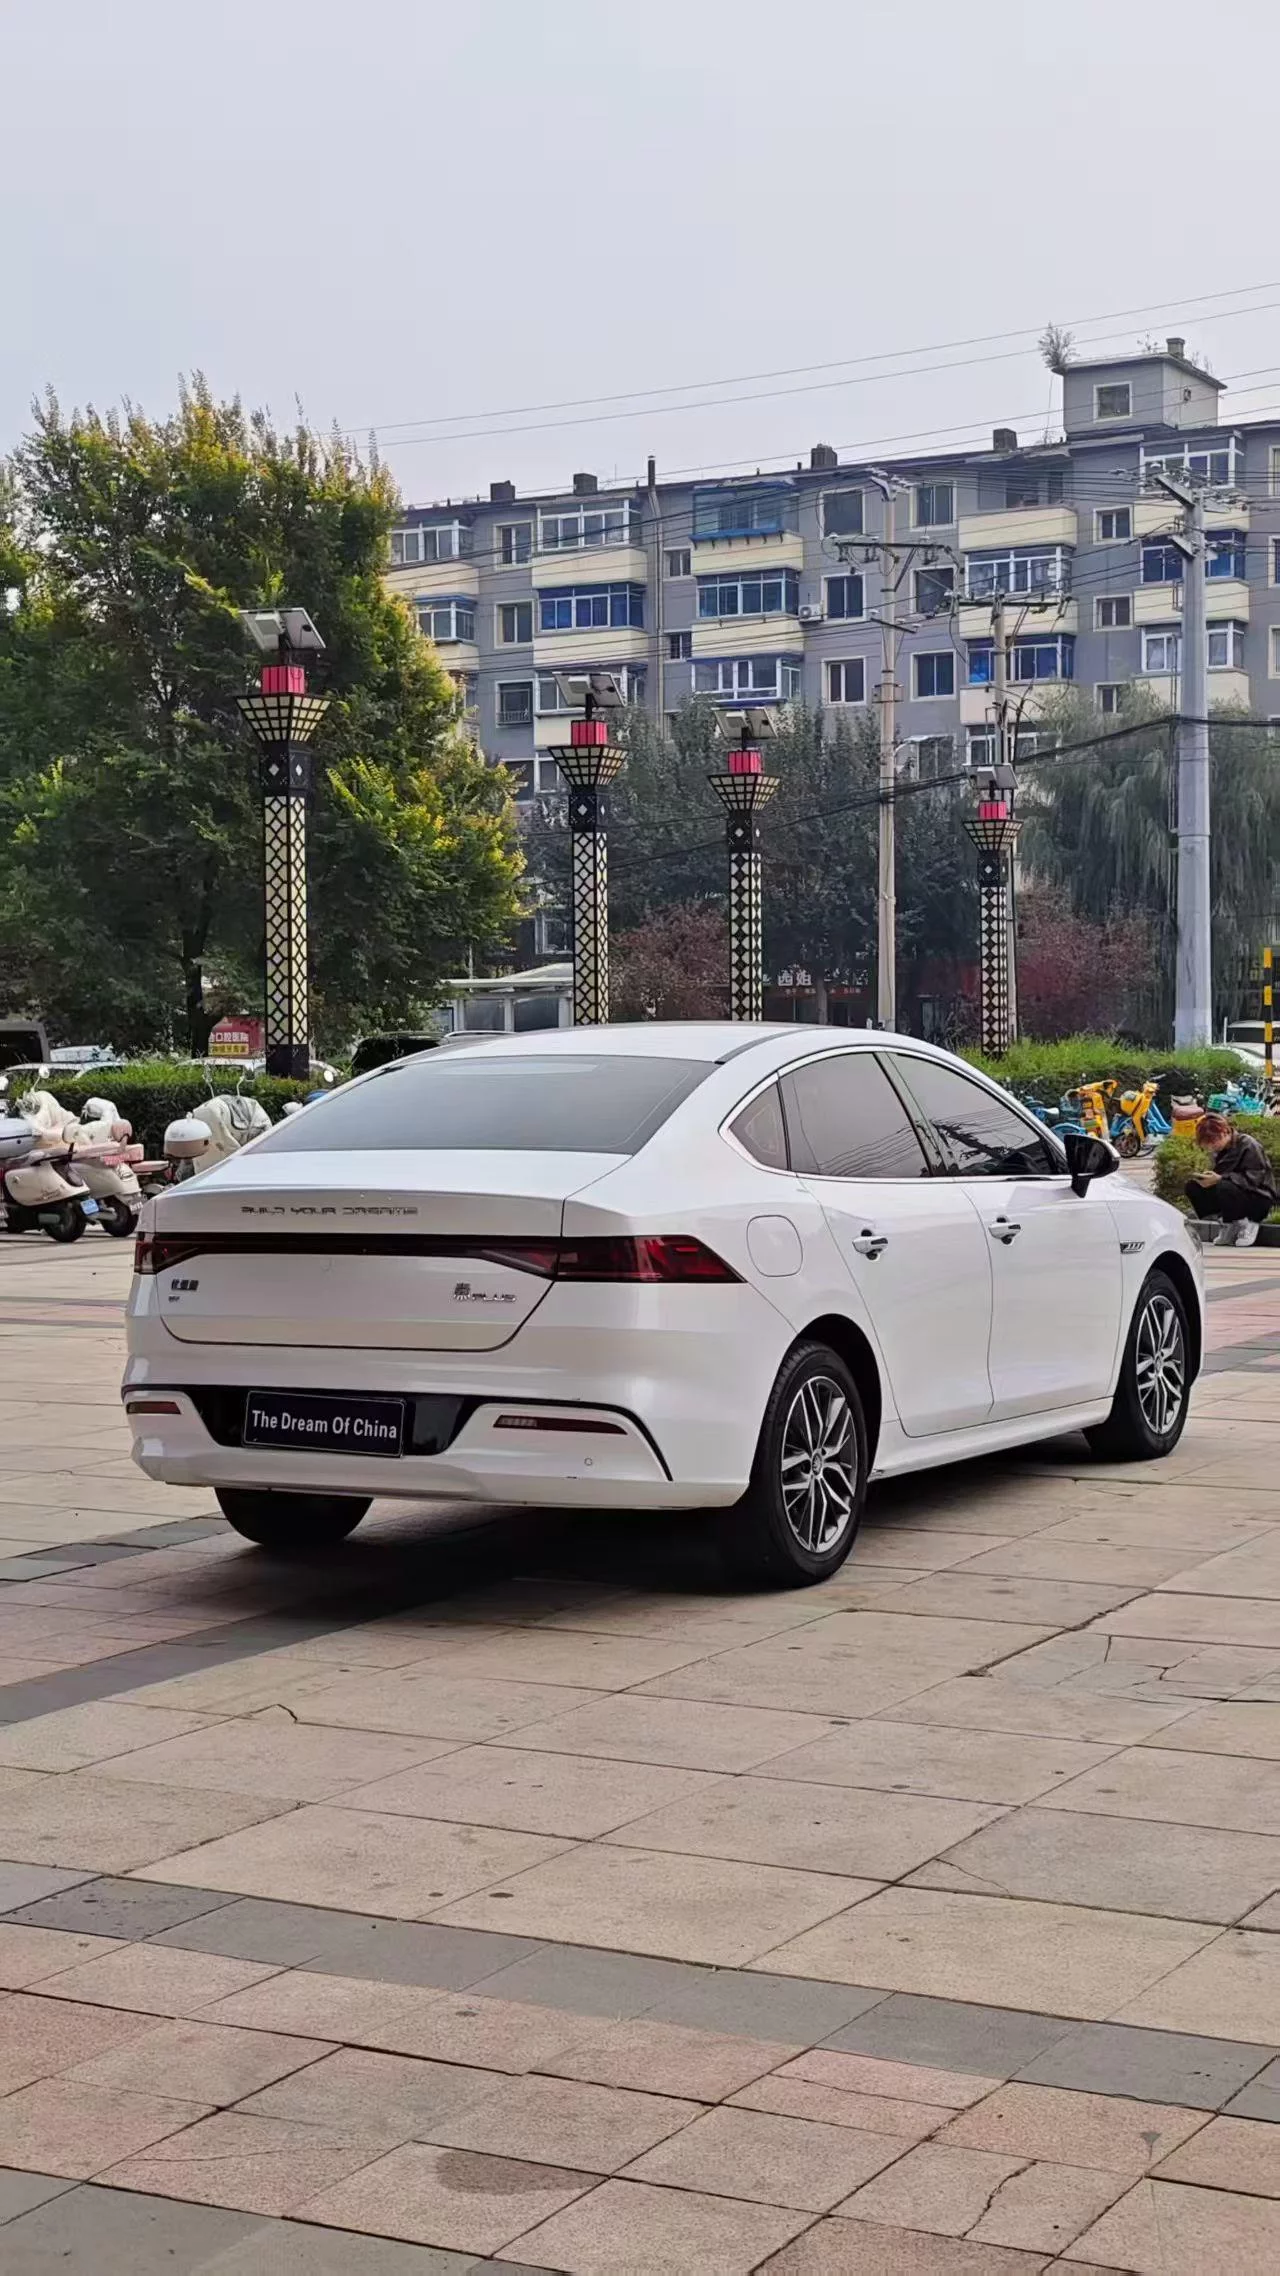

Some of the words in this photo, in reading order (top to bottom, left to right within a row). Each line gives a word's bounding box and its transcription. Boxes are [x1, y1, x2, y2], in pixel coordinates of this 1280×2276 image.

[290, 1205, 337, 1216] YOUR
[251, 1409, 278, 1429] The
[281, 1412, 329, 1433] Dream
[332, 1416, 351, 1435] Of
[353, 1418, 398, 1440] China
